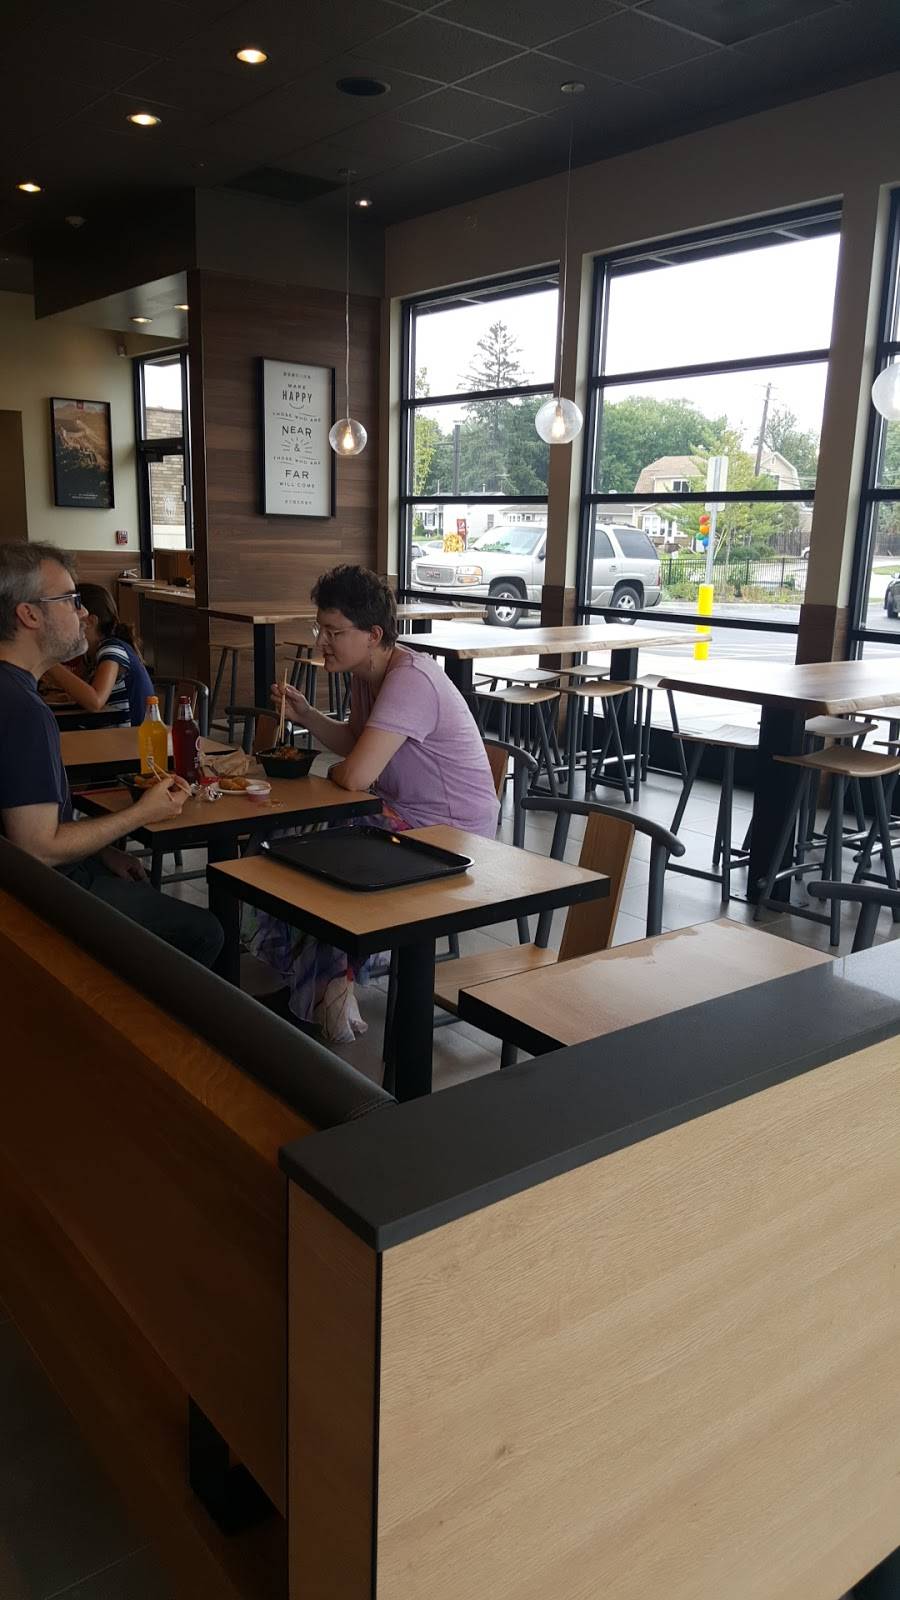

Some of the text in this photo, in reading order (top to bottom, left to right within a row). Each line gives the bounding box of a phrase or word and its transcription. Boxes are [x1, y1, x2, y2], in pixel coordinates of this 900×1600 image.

[282, 390, 312, 403] HAPPY
[282, 426, 312, 438] NEAR
[294, 443, 300, 452] &
[286, 470, 309, 479] FAR
